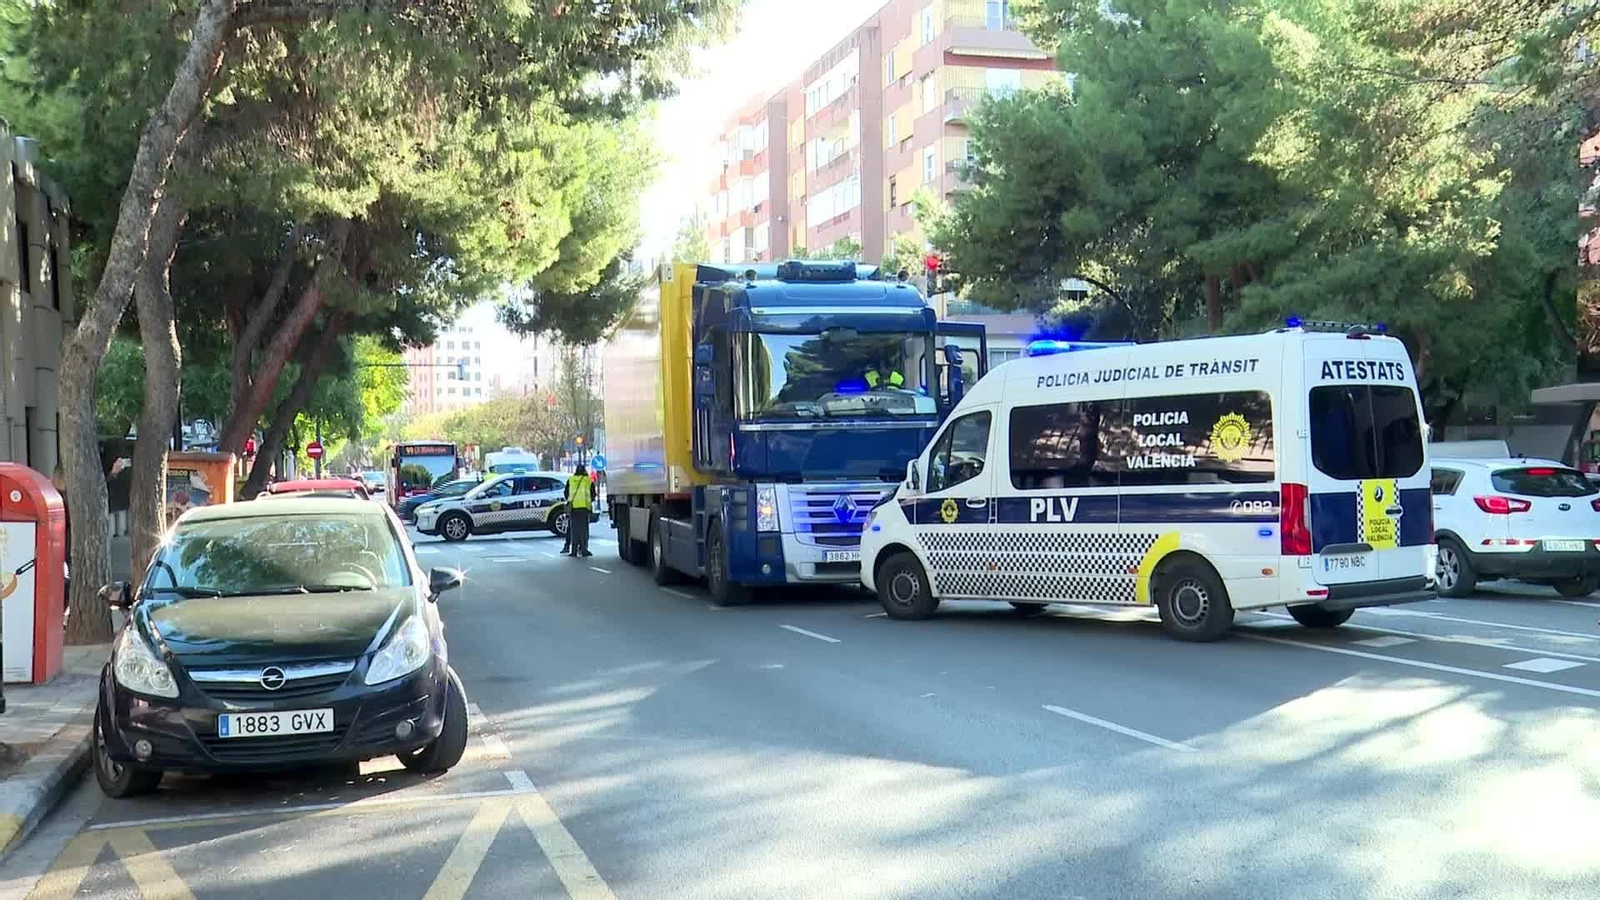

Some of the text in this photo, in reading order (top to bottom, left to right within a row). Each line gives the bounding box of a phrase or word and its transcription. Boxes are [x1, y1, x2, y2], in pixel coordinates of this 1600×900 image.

[1037, 358, 1259, 389] POLICIA JUDICIAL DE TRÀNSIT
[1321, 360, 1405, 381] ATESTATS
[1133, 411, 1190, 427] POLICIA
[1138, 433, 1185, 448] LOCAL
[1126, 453, 1197, 469] VALENCIA
[523, 499, 542, 508] PLV
[1030, 497, 1079, 522] PLV
[1243, 500, 1273, 513] 092
[1369, 518, 1391, 526] POLICIA
[1367, 533, 1393, 542] VALENCIA
[1371, 526, 1389, 534] LOCAL
[828, 551, 850, 561] 3862
[1330, 555, 1366, 571] 7790 NBC
[235, 712, 326, 734] 1883 GVX
